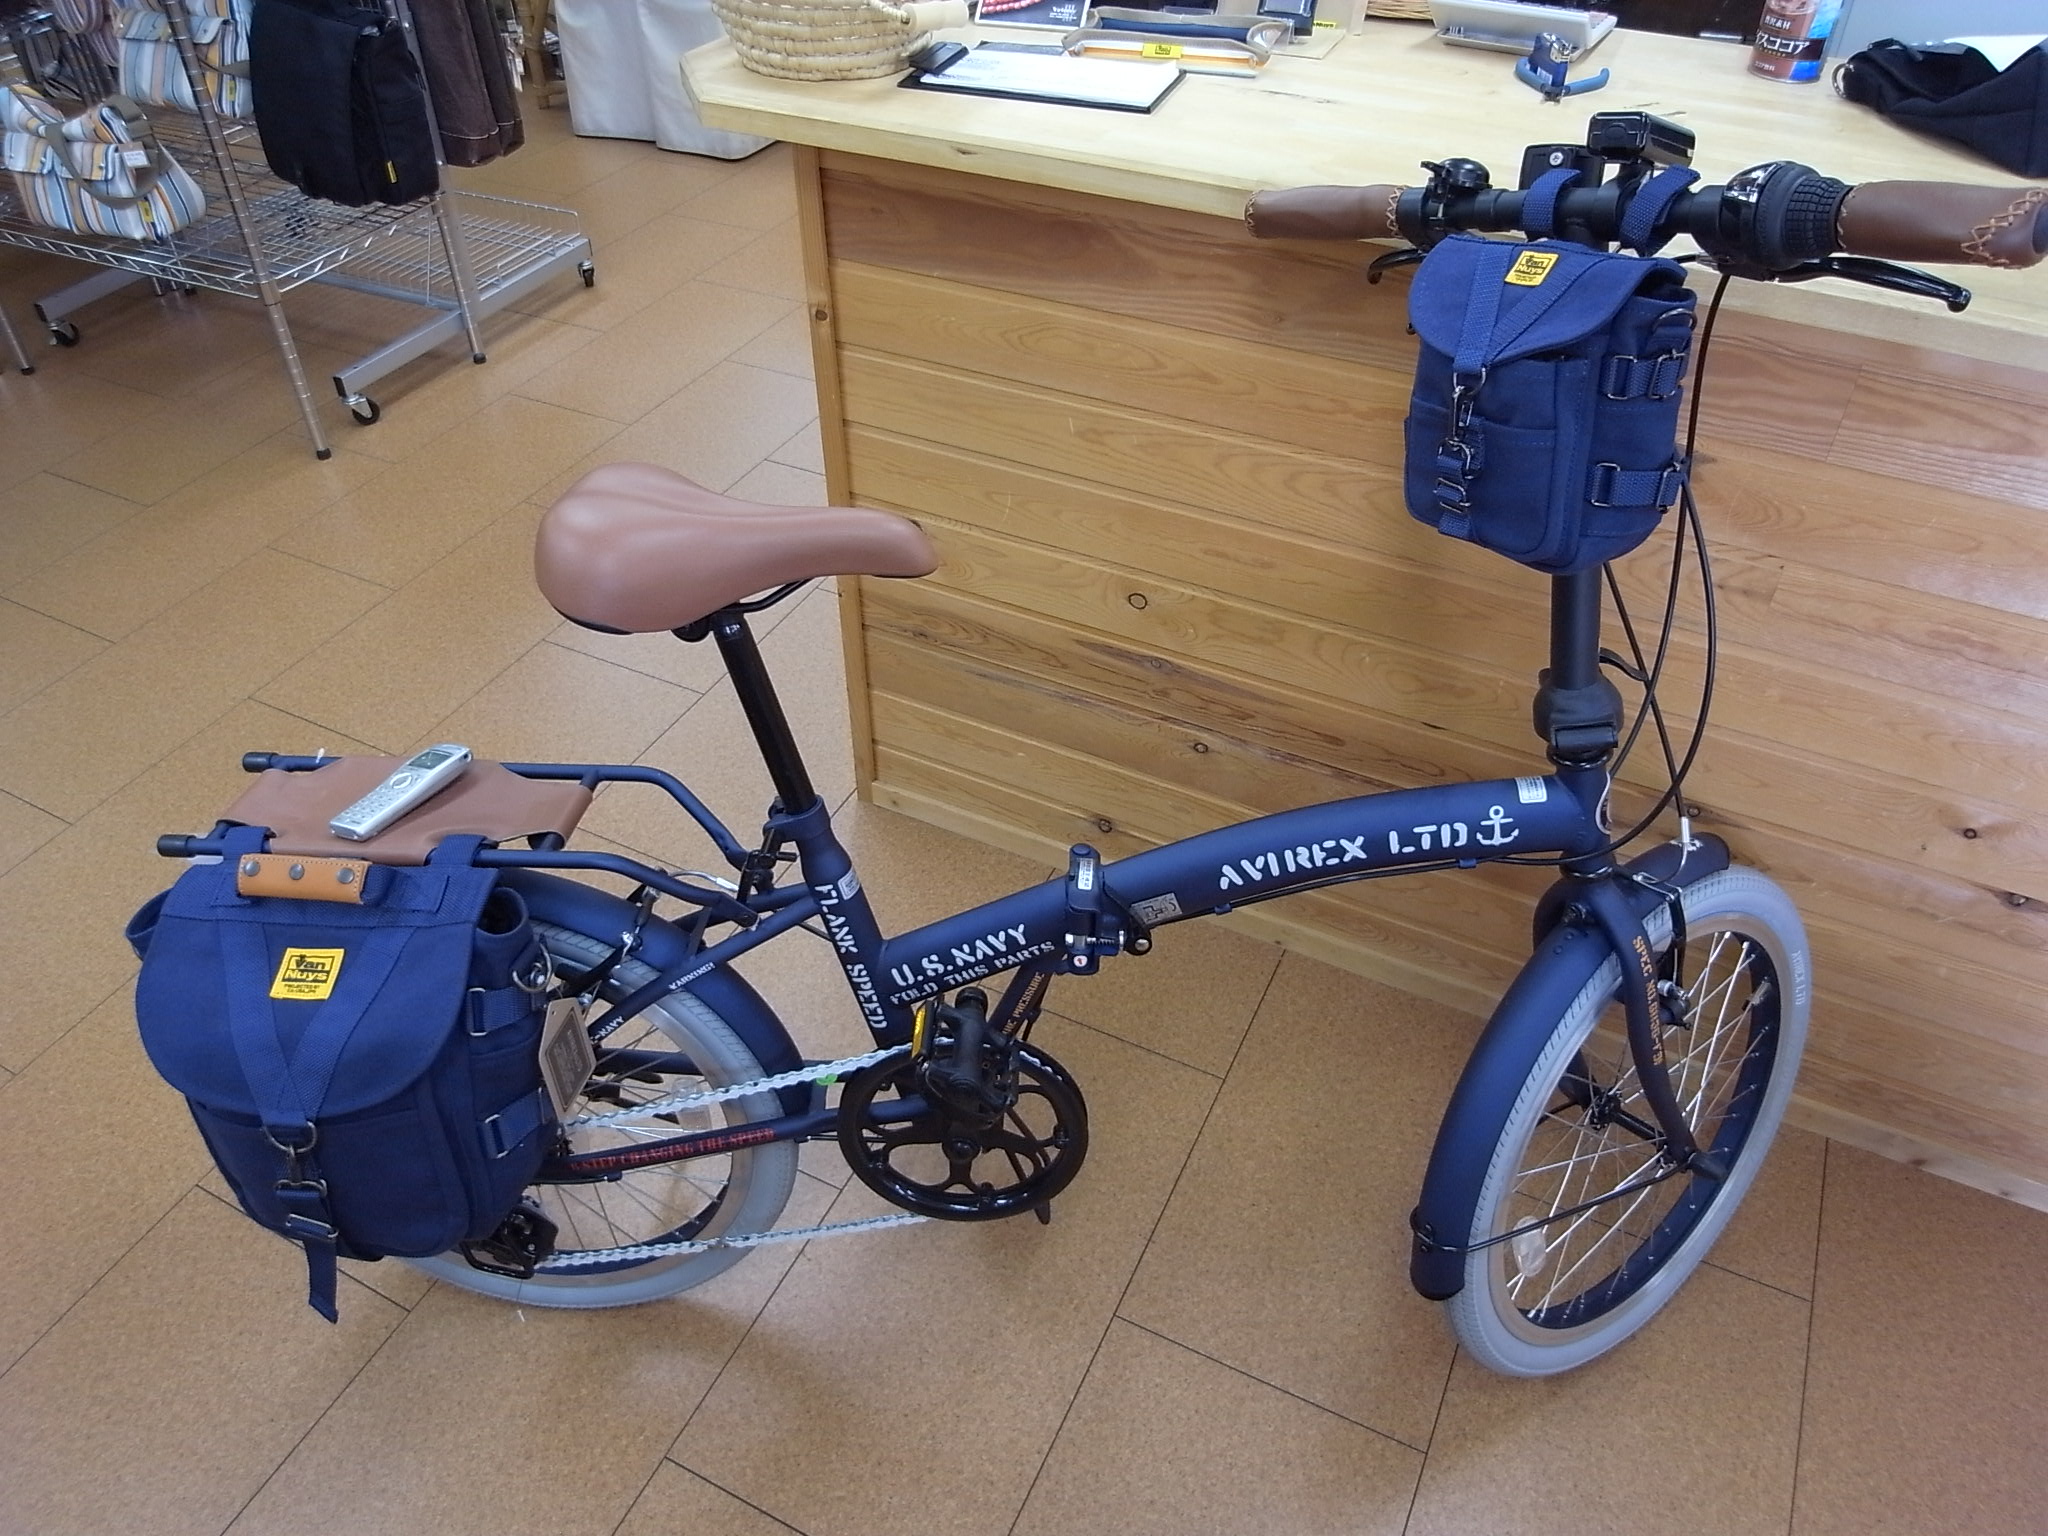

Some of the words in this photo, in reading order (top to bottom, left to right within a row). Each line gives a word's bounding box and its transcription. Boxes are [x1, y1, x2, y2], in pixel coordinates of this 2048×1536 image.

[1516, 264, 1545, 274] Nuys
[1525, 257, 1544, 267] Van
[1219, 835, 1367, 890] AVIREX
[1389, 822, 1468, 855] LTD
[284, 970, 328, 981] Nuys
[294, 957, 325, 969] Van
[814, 884, 858, 954] FLANK
[846, 963, 888, 1029] SPEED
[889, 982, 938, 1005] FOLD
[944, 964, 989, 986] THIS
[993, 941, 1055, 969] PARTS
[891, 923, 1026, 987] U.S.NAVY
[1632, 935, 1653, 977] SPEC
[1012, 971, 1045, 1018] PRESSURE
